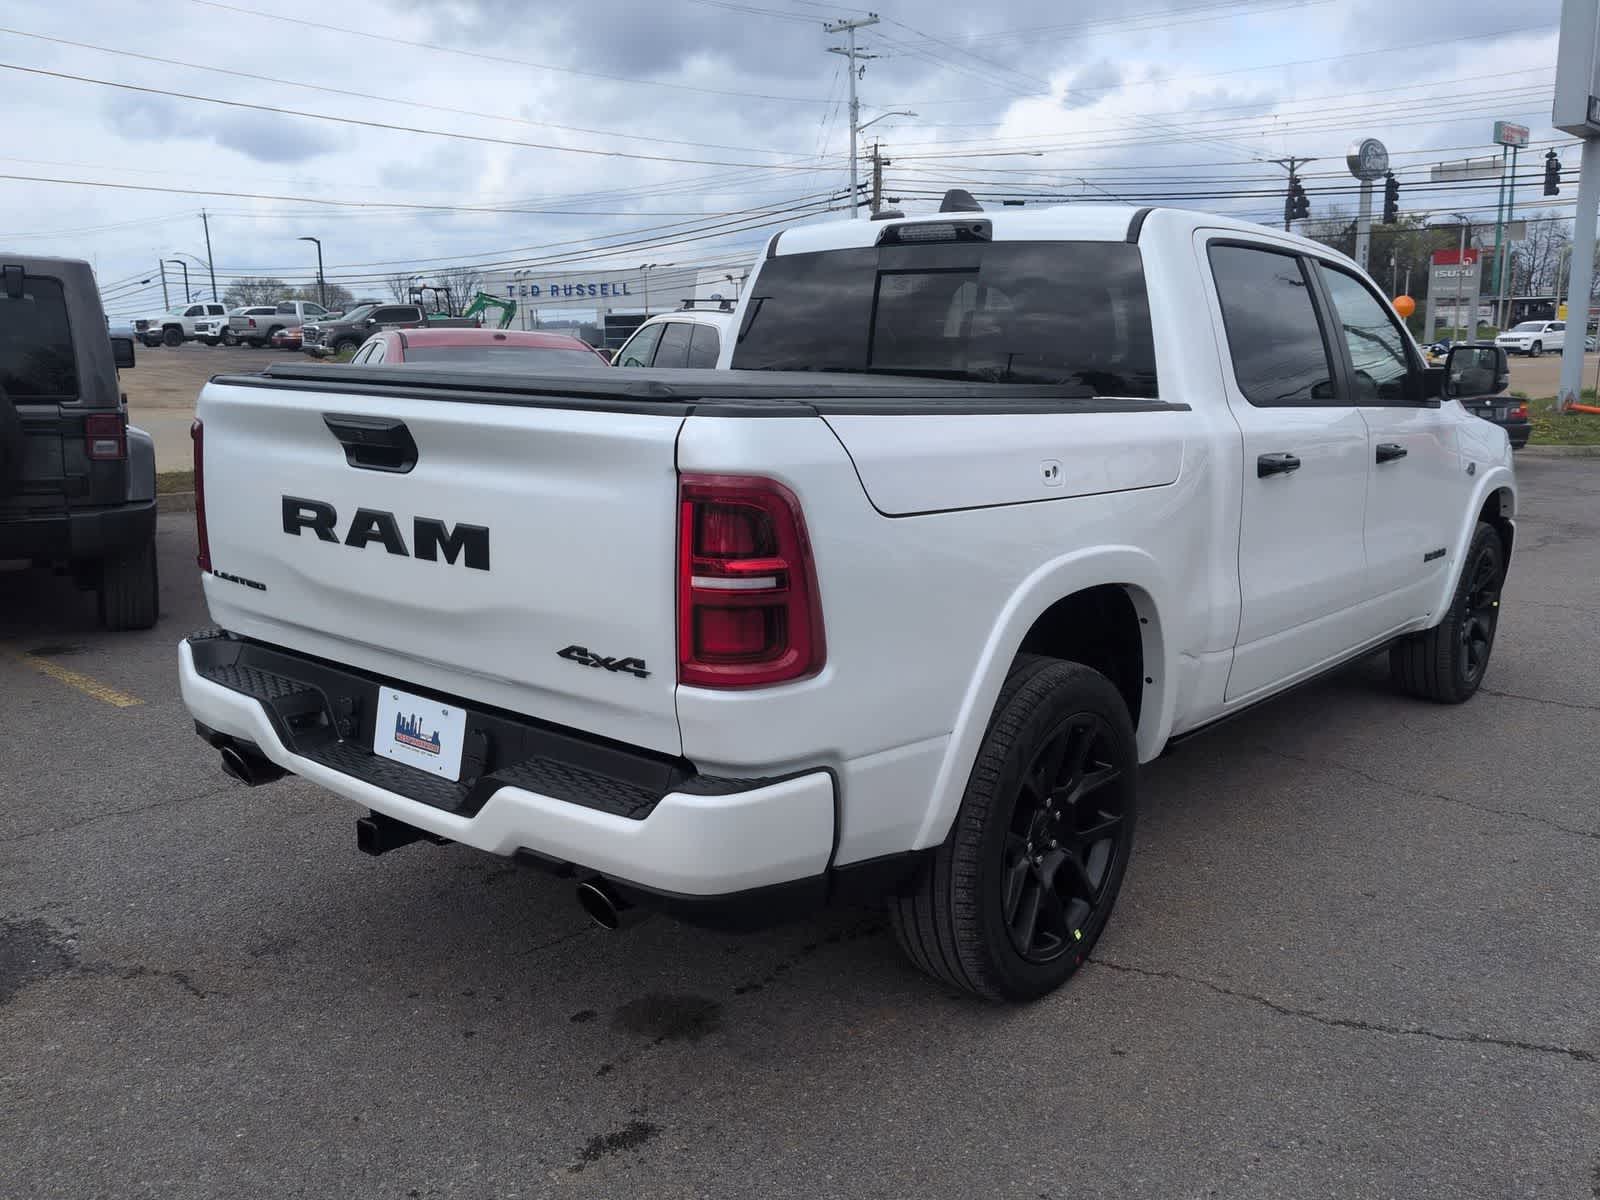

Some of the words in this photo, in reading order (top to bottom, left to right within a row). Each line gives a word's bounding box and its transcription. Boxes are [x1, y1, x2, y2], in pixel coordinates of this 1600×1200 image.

[506, 285, 540, 297] TED
[550, 283, 632, 297] RUSSELL
[282, 495, 490, 571] RAM
